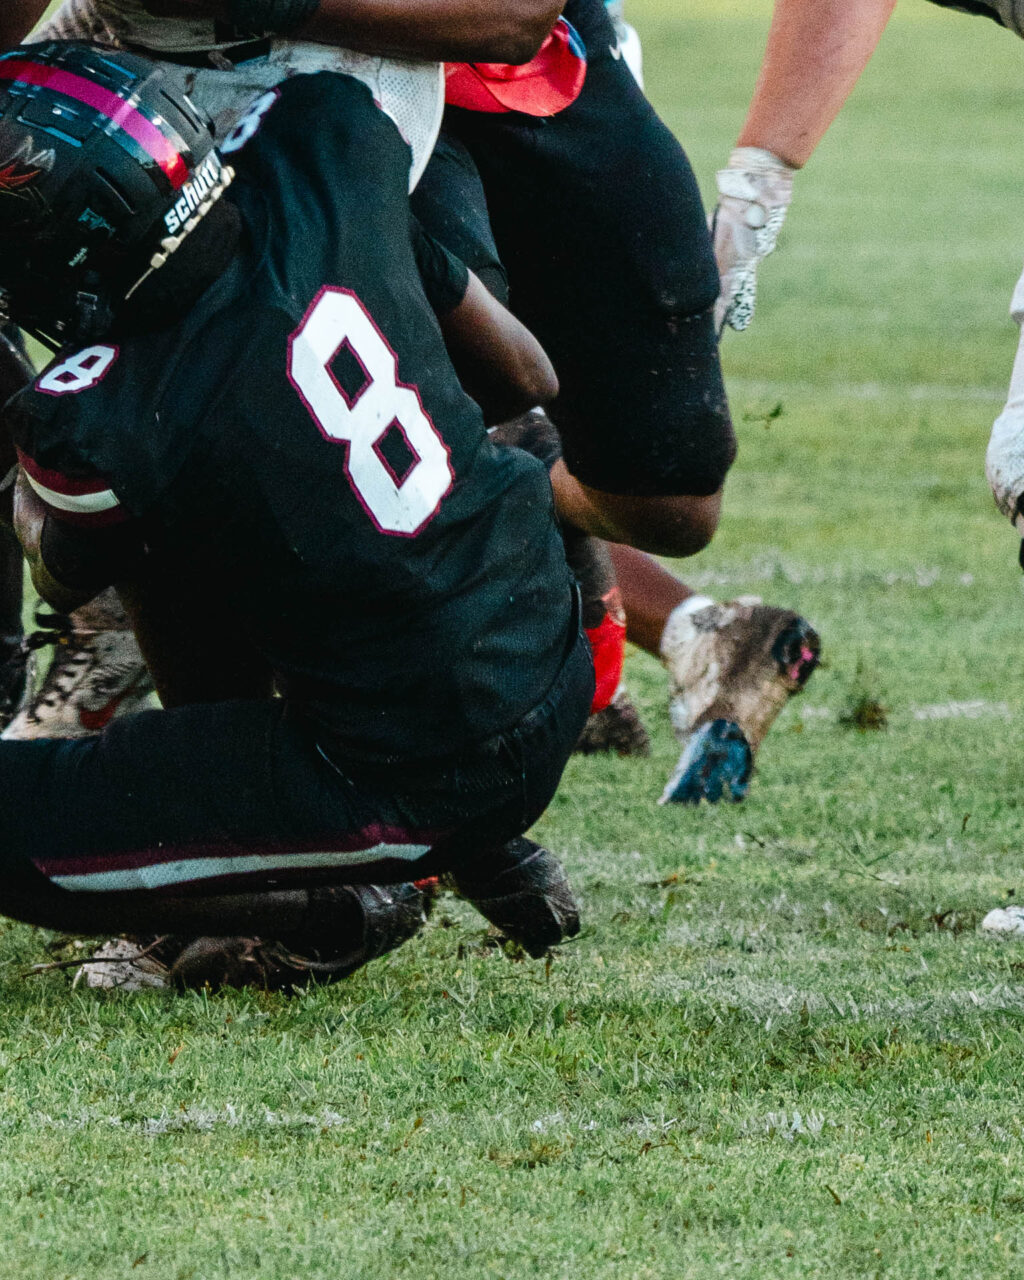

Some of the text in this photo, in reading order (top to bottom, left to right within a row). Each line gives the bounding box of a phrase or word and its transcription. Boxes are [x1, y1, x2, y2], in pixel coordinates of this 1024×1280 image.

[219, 87, 281, 154] 8
[35, 343, 120, 398] 8
[286, 283, 457, 539] 8
